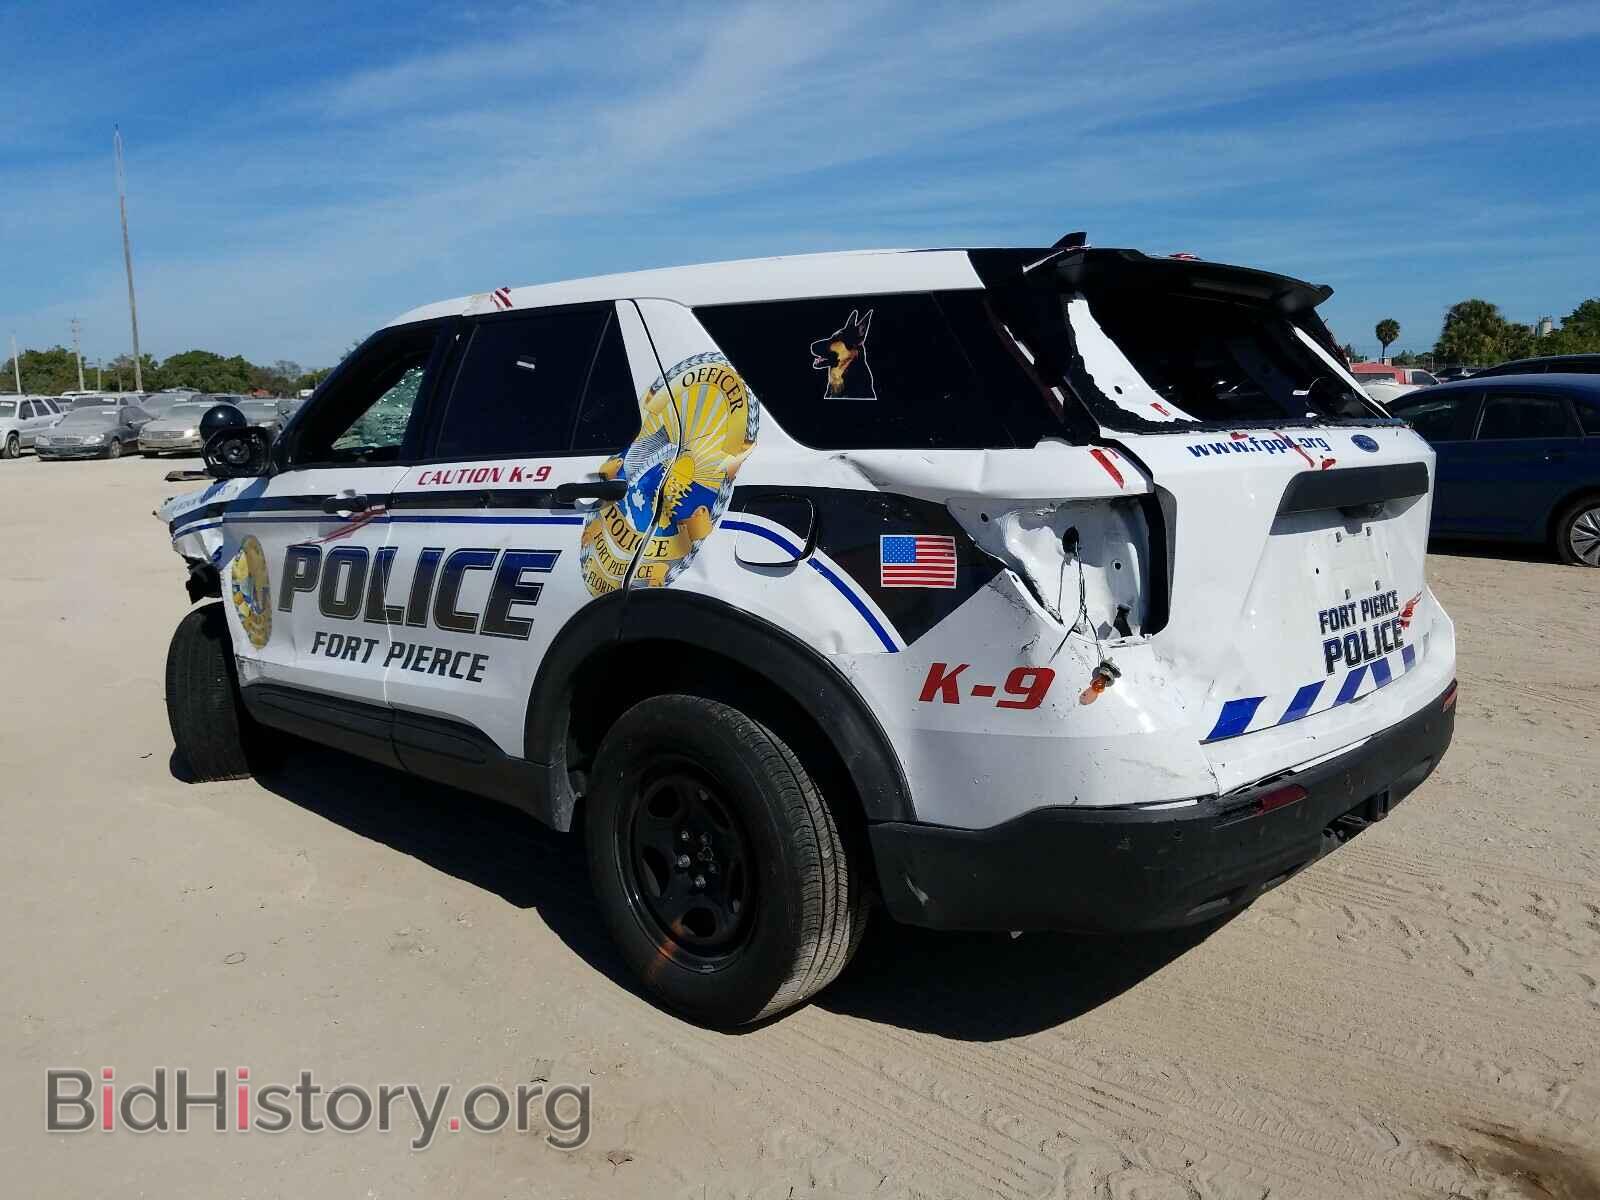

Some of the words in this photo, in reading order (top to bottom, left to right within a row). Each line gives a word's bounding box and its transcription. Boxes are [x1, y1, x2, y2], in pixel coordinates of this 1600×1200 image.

[682, 367, 744, 414] OFFICER
[417, 466, 505, 486] CAUTION
[508, 466, 552, 483] K-9
[594, 531, 612, 564] FORT
[608, 559, 655, 578] PIECE
[604, 506, 669, 558] POLICE
[277, 545, 563, 641] POLICE
[1319, 602, 1357, 634] FORT
[1361, 590, 1400, 622] PIERCE
[311, 631, 380, 664] FORT
[384, 642, 489, 683] PIERCE
[1323, 619, 1404, 676] POLICE
[918, 662, 1056, 710] K-9
